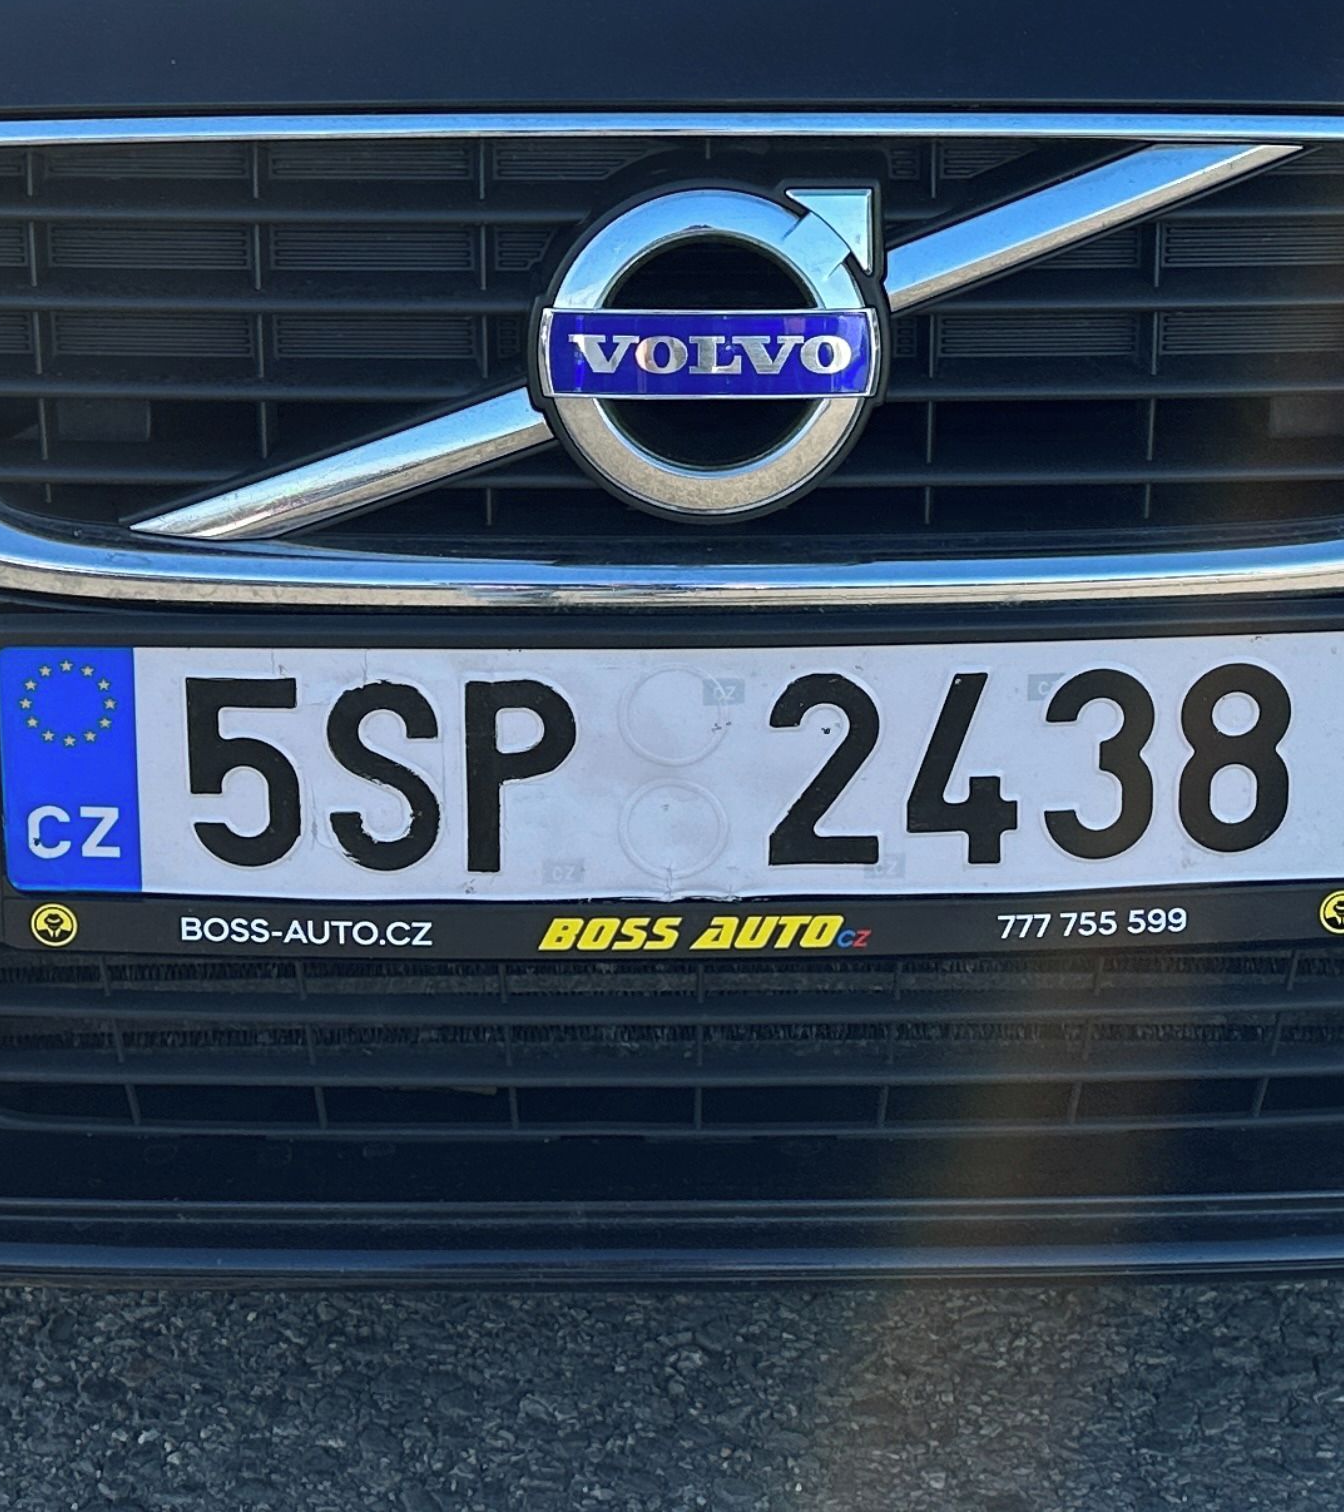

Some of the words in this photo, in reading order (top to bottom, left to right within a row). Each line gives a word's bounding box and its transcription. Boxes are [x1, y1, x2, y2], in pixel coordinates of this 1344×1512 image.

[568, 334, 852, 375] VOLVO
[28, 805, 120, 859] CZ
[186, 678, 577, 872] 5SP
[768, 663, 1292, 864] 2438
[181, 917, 432, 946] BOSS-AUTO.CZ
[538, 917, 683, 951] BOSS
[997, 913, 1051, 939] 777
[1060, 910, 1117, 936] 755
[1127, 907, 1187, 933] 599
